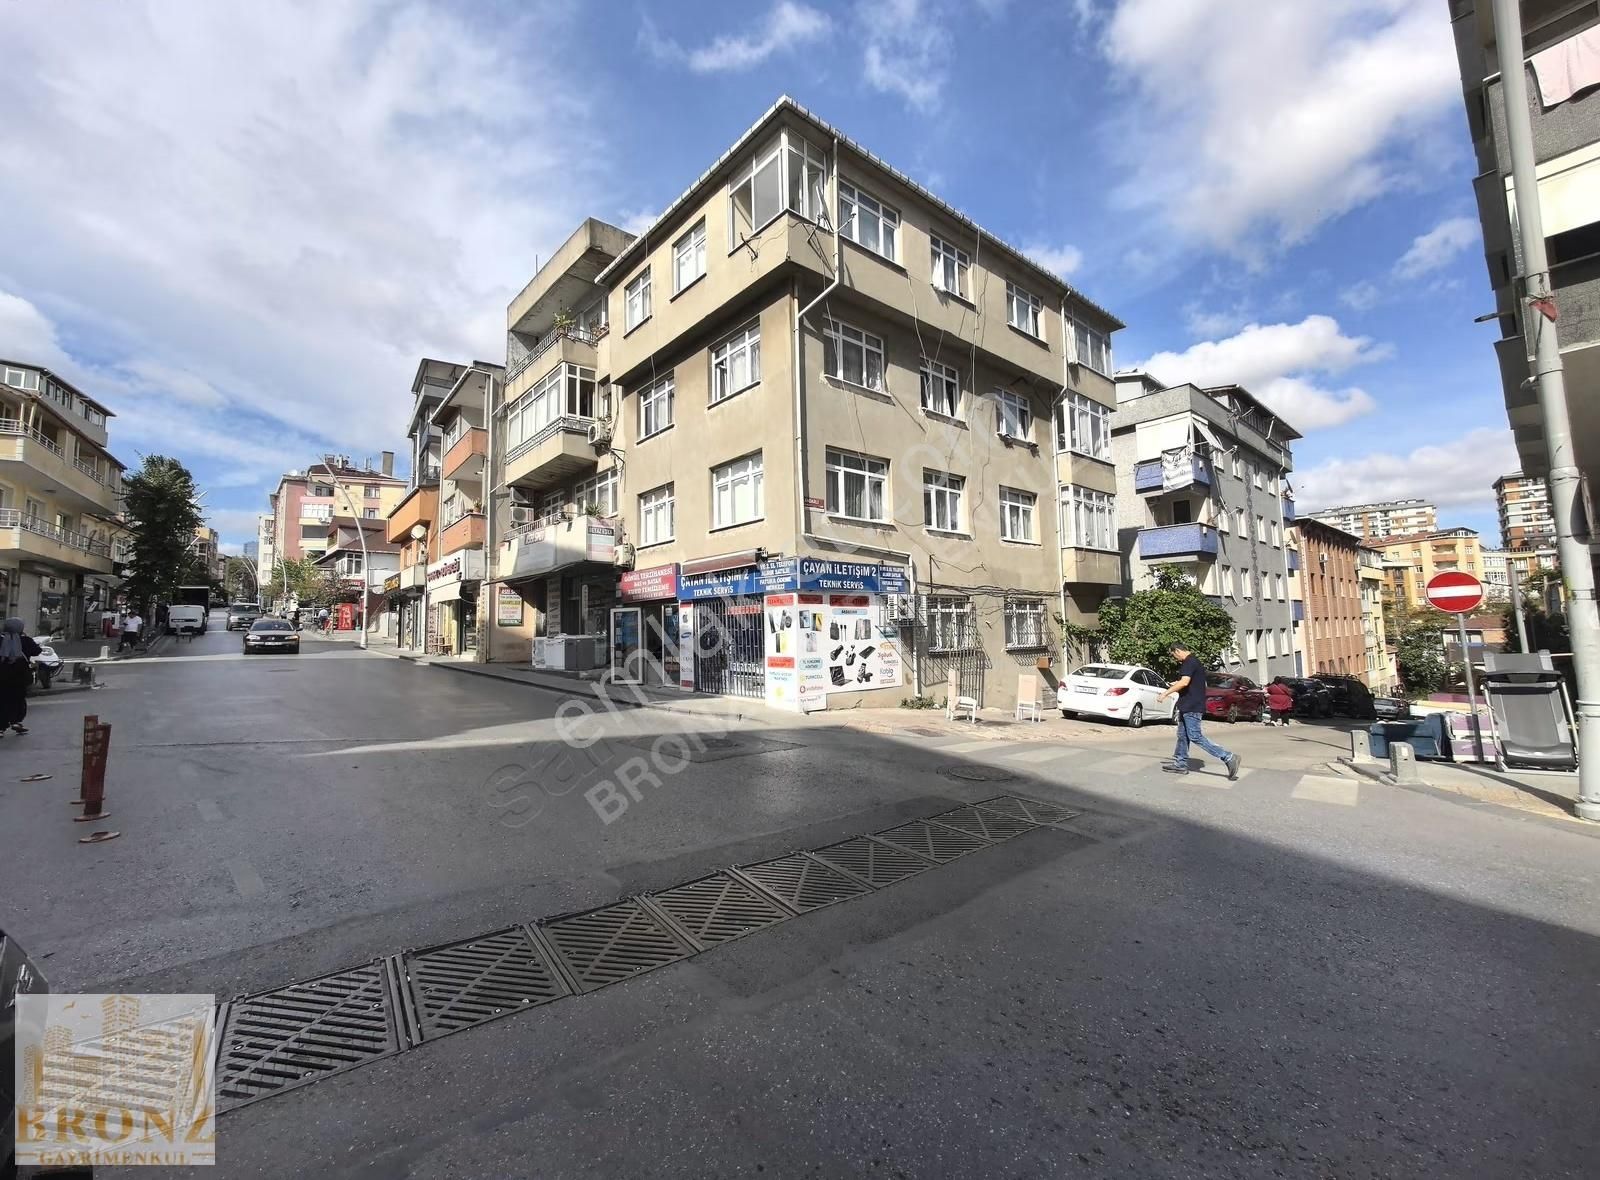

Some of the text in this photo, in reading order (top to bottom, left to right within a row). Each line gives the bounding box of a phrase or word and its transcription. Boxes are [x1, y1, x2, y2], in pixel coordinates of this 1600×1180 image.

[803, 561, 877, 578] ÇAYAN İLETİŞİM 2
[818, 580, 864, 590] TEKNİK SERVİS
[714, 586, 734, 595] SERVİS
